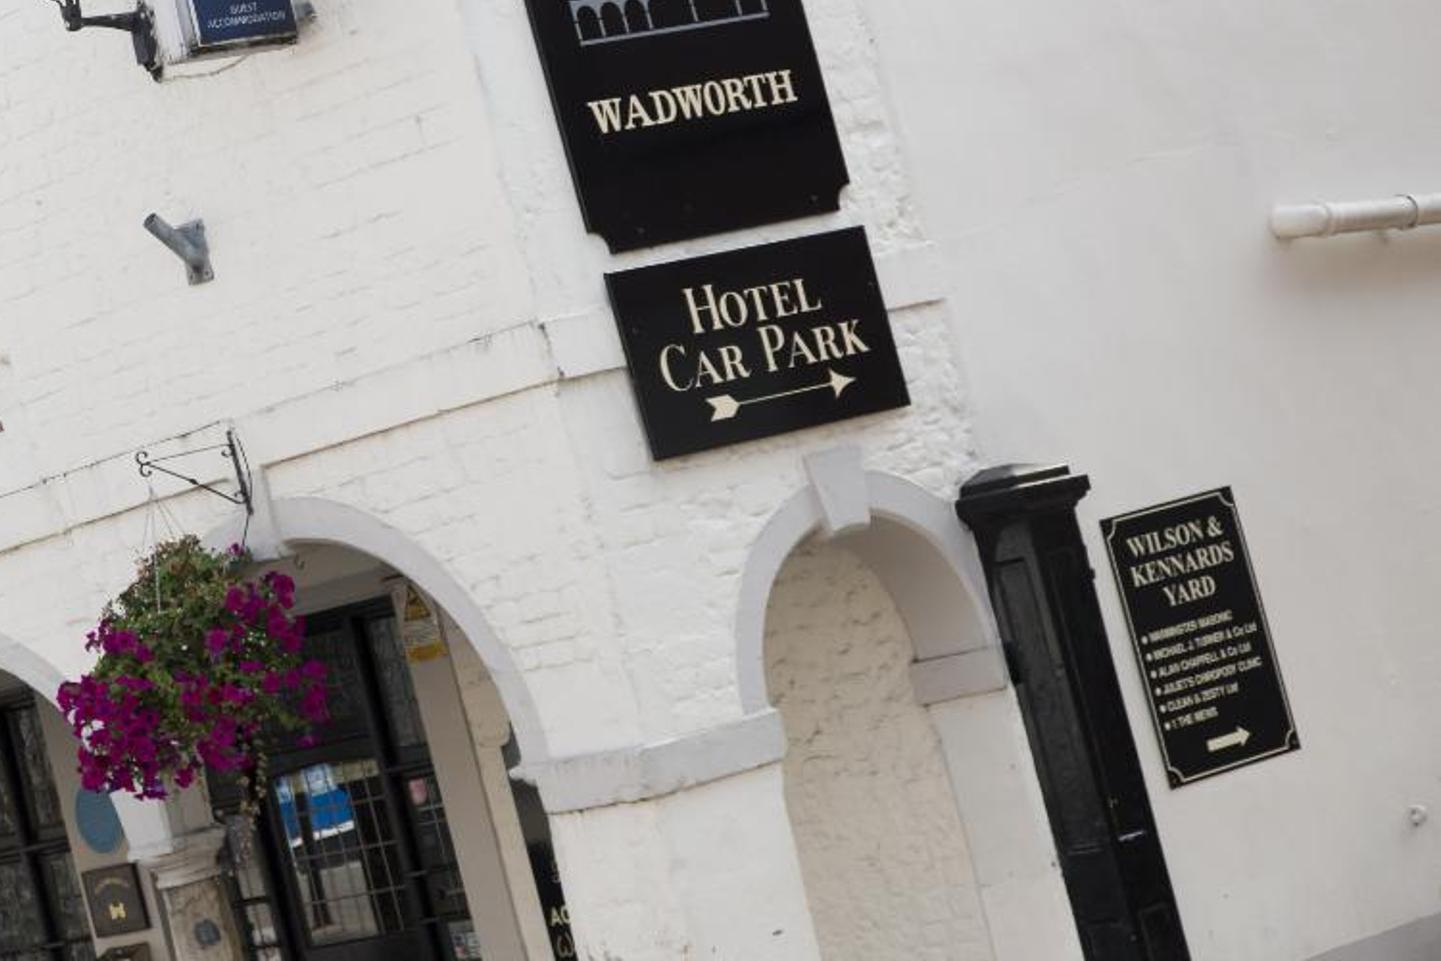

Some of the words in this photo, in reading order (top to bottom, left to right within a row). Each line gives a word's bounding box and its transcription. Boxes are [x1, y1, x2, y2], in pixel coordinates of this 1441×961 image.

[588, 69, 798, 134] WADWORTH
[683, 278, 822, 334] HOTEL
[660, 344, 751, 392] CAR
[758, 319, 870, 372] PARK
[1126, 519, 1205, 558] WILSON
[1207, 515, 1224, 538] &
[1130, 541, 1235, 587] KENNARDS
[1163, 576, 1216, 607] YARD
